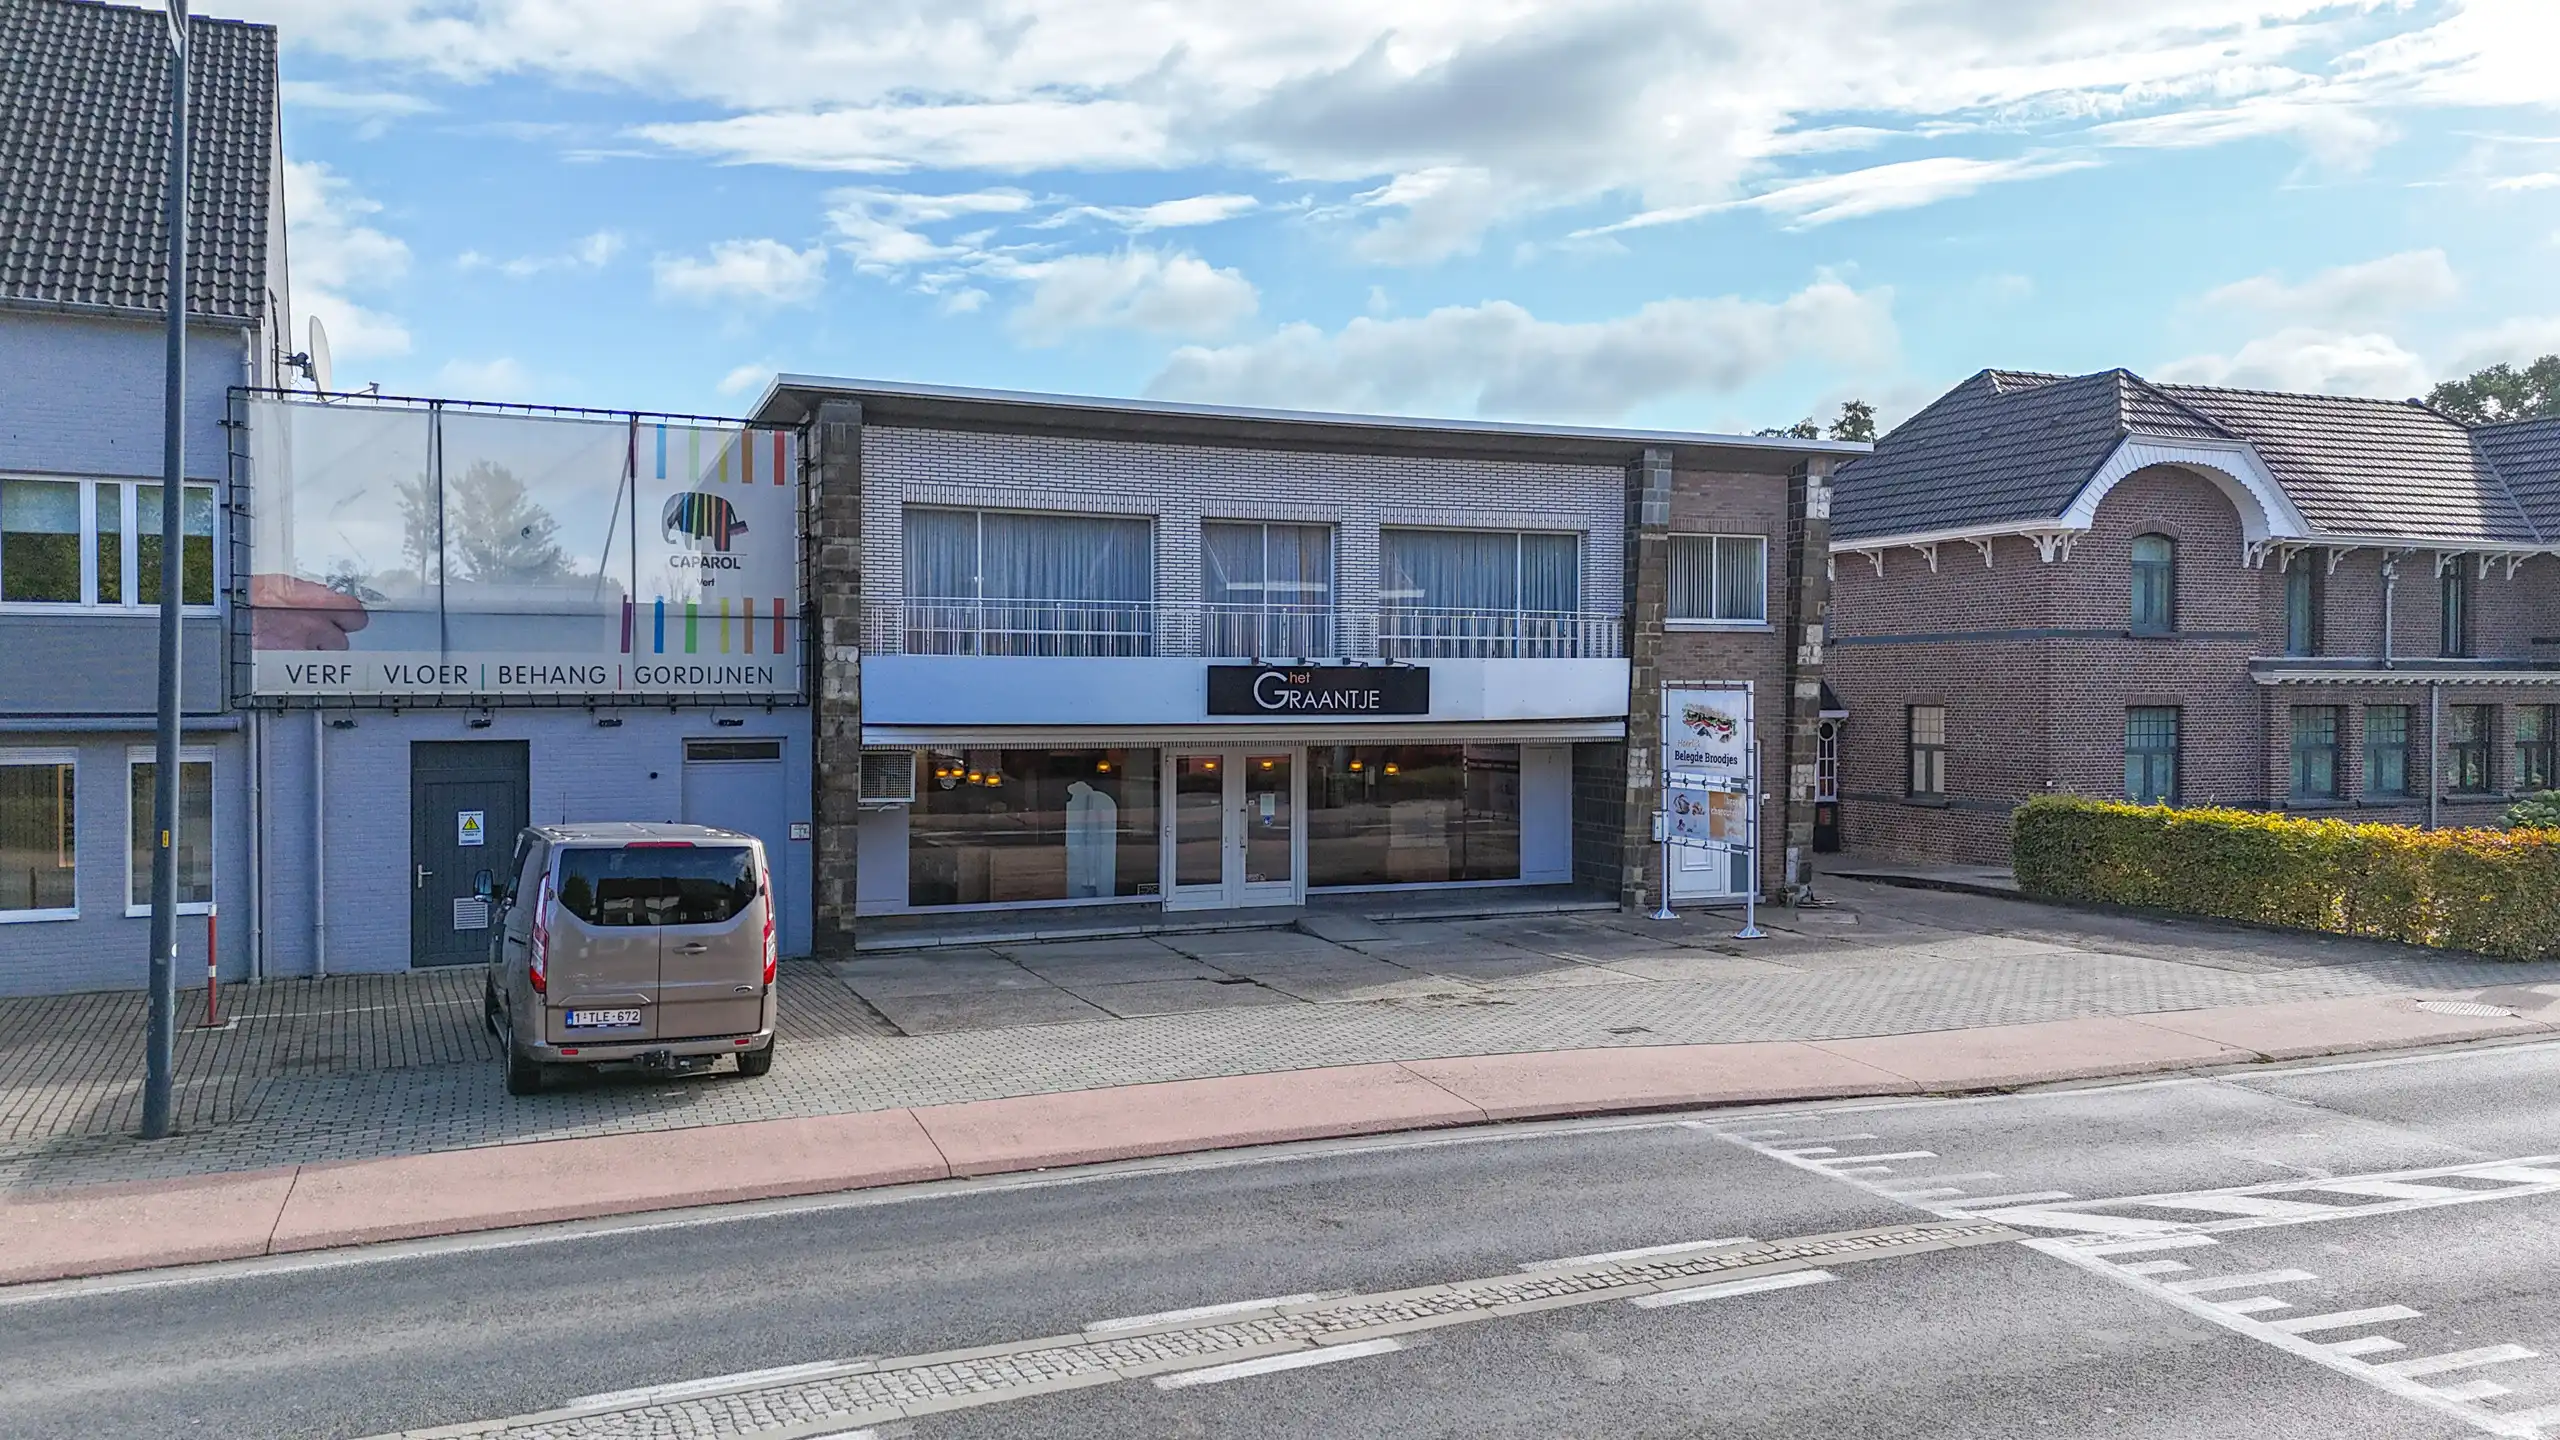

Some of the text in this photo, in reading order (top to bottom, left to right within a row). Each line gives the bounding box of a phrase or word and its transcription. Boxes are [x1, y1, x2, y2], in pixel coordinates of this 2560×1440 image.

[669, 555, 741, 570] CAPAROL
[696, 578, 715, 587] Verf
[285, 664, 773, 685] VERF VLOER BEHANG GORDIJNEN
[1289, 672, 1312, 684] het
[1253, 671, 1380, 709] GRAANTJE
[1674, 750, 1738, 767] Belegde Broodjes
